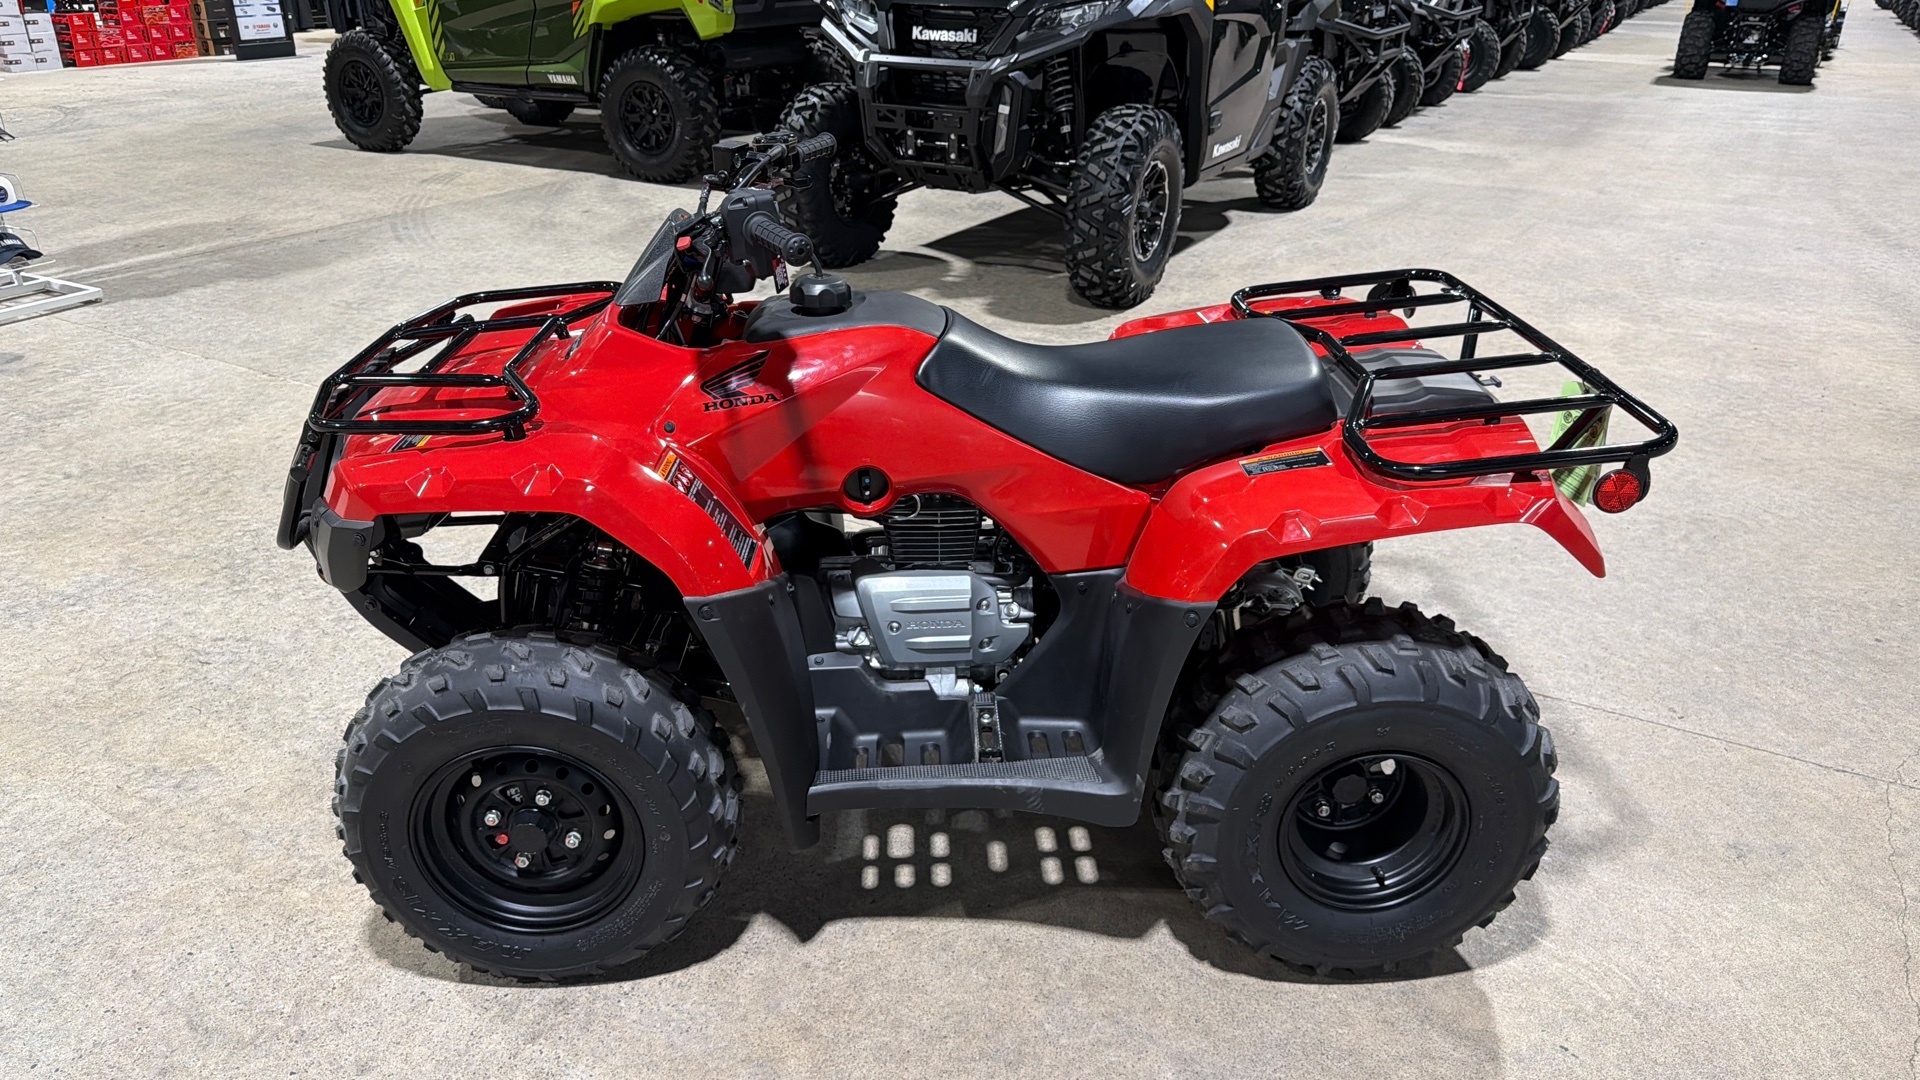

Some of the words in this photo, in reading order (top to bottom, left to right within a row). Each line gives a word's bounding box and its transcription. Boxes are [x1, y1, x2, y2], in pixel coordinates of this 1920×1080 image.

[912, 25, 978, 43] Kawasaki
[546, 73, 578, 85] YAMAHA
[1211, 134, 1242, 159] Kawasaki
[703, 393, 779, 413] HONDA
[906, 619, 966, 630] HONDA
